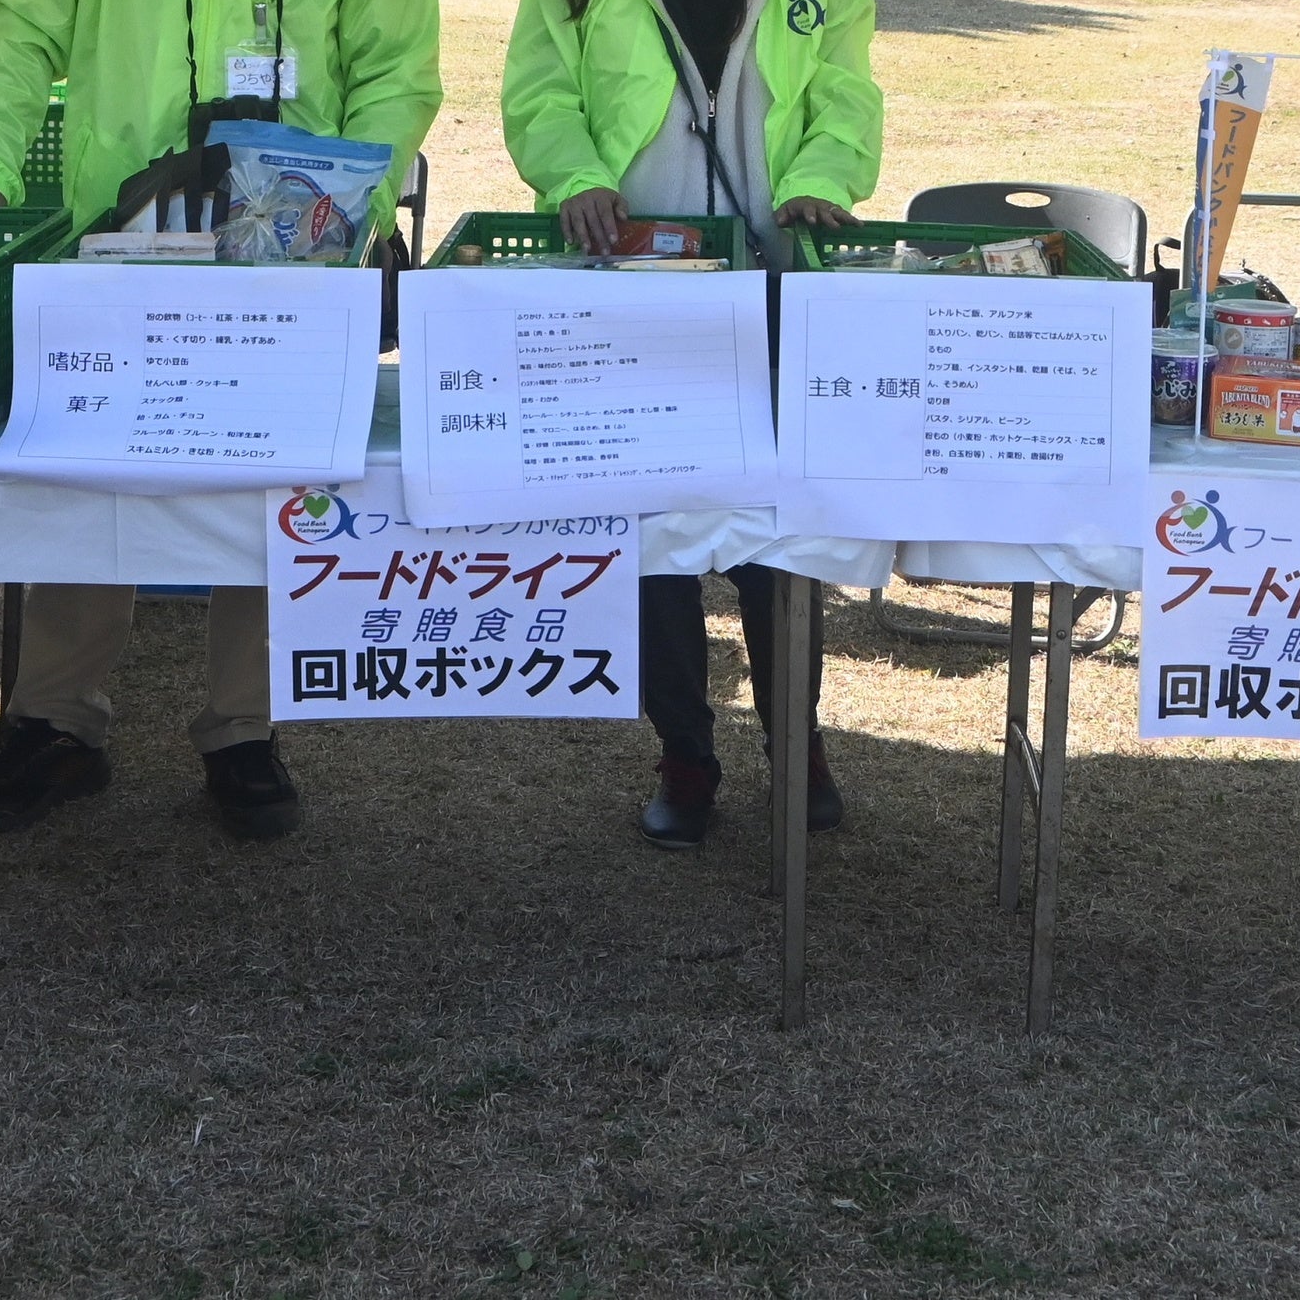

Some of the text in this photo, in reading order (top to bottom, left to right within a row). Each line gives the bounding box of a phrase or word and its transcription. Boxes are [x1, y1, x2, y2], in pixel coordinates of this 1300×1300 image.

[235, 73, 284, 85] つちや
[928, 346, 952, 354] るもの
[439, 369, 498, 391] 副食・
[808, 376, 920, 398] 主食・麺類
[65, 396, 111, 413] 菓子
[441, 411, 507, 433] 調味料
[924, 466, 949, 475] パン粉
[289, 548, 621, 601] フードドライブ
[360, 607, 567, 643] 寄贈食品
[292, 645, 620, 703] 回収ボックス
